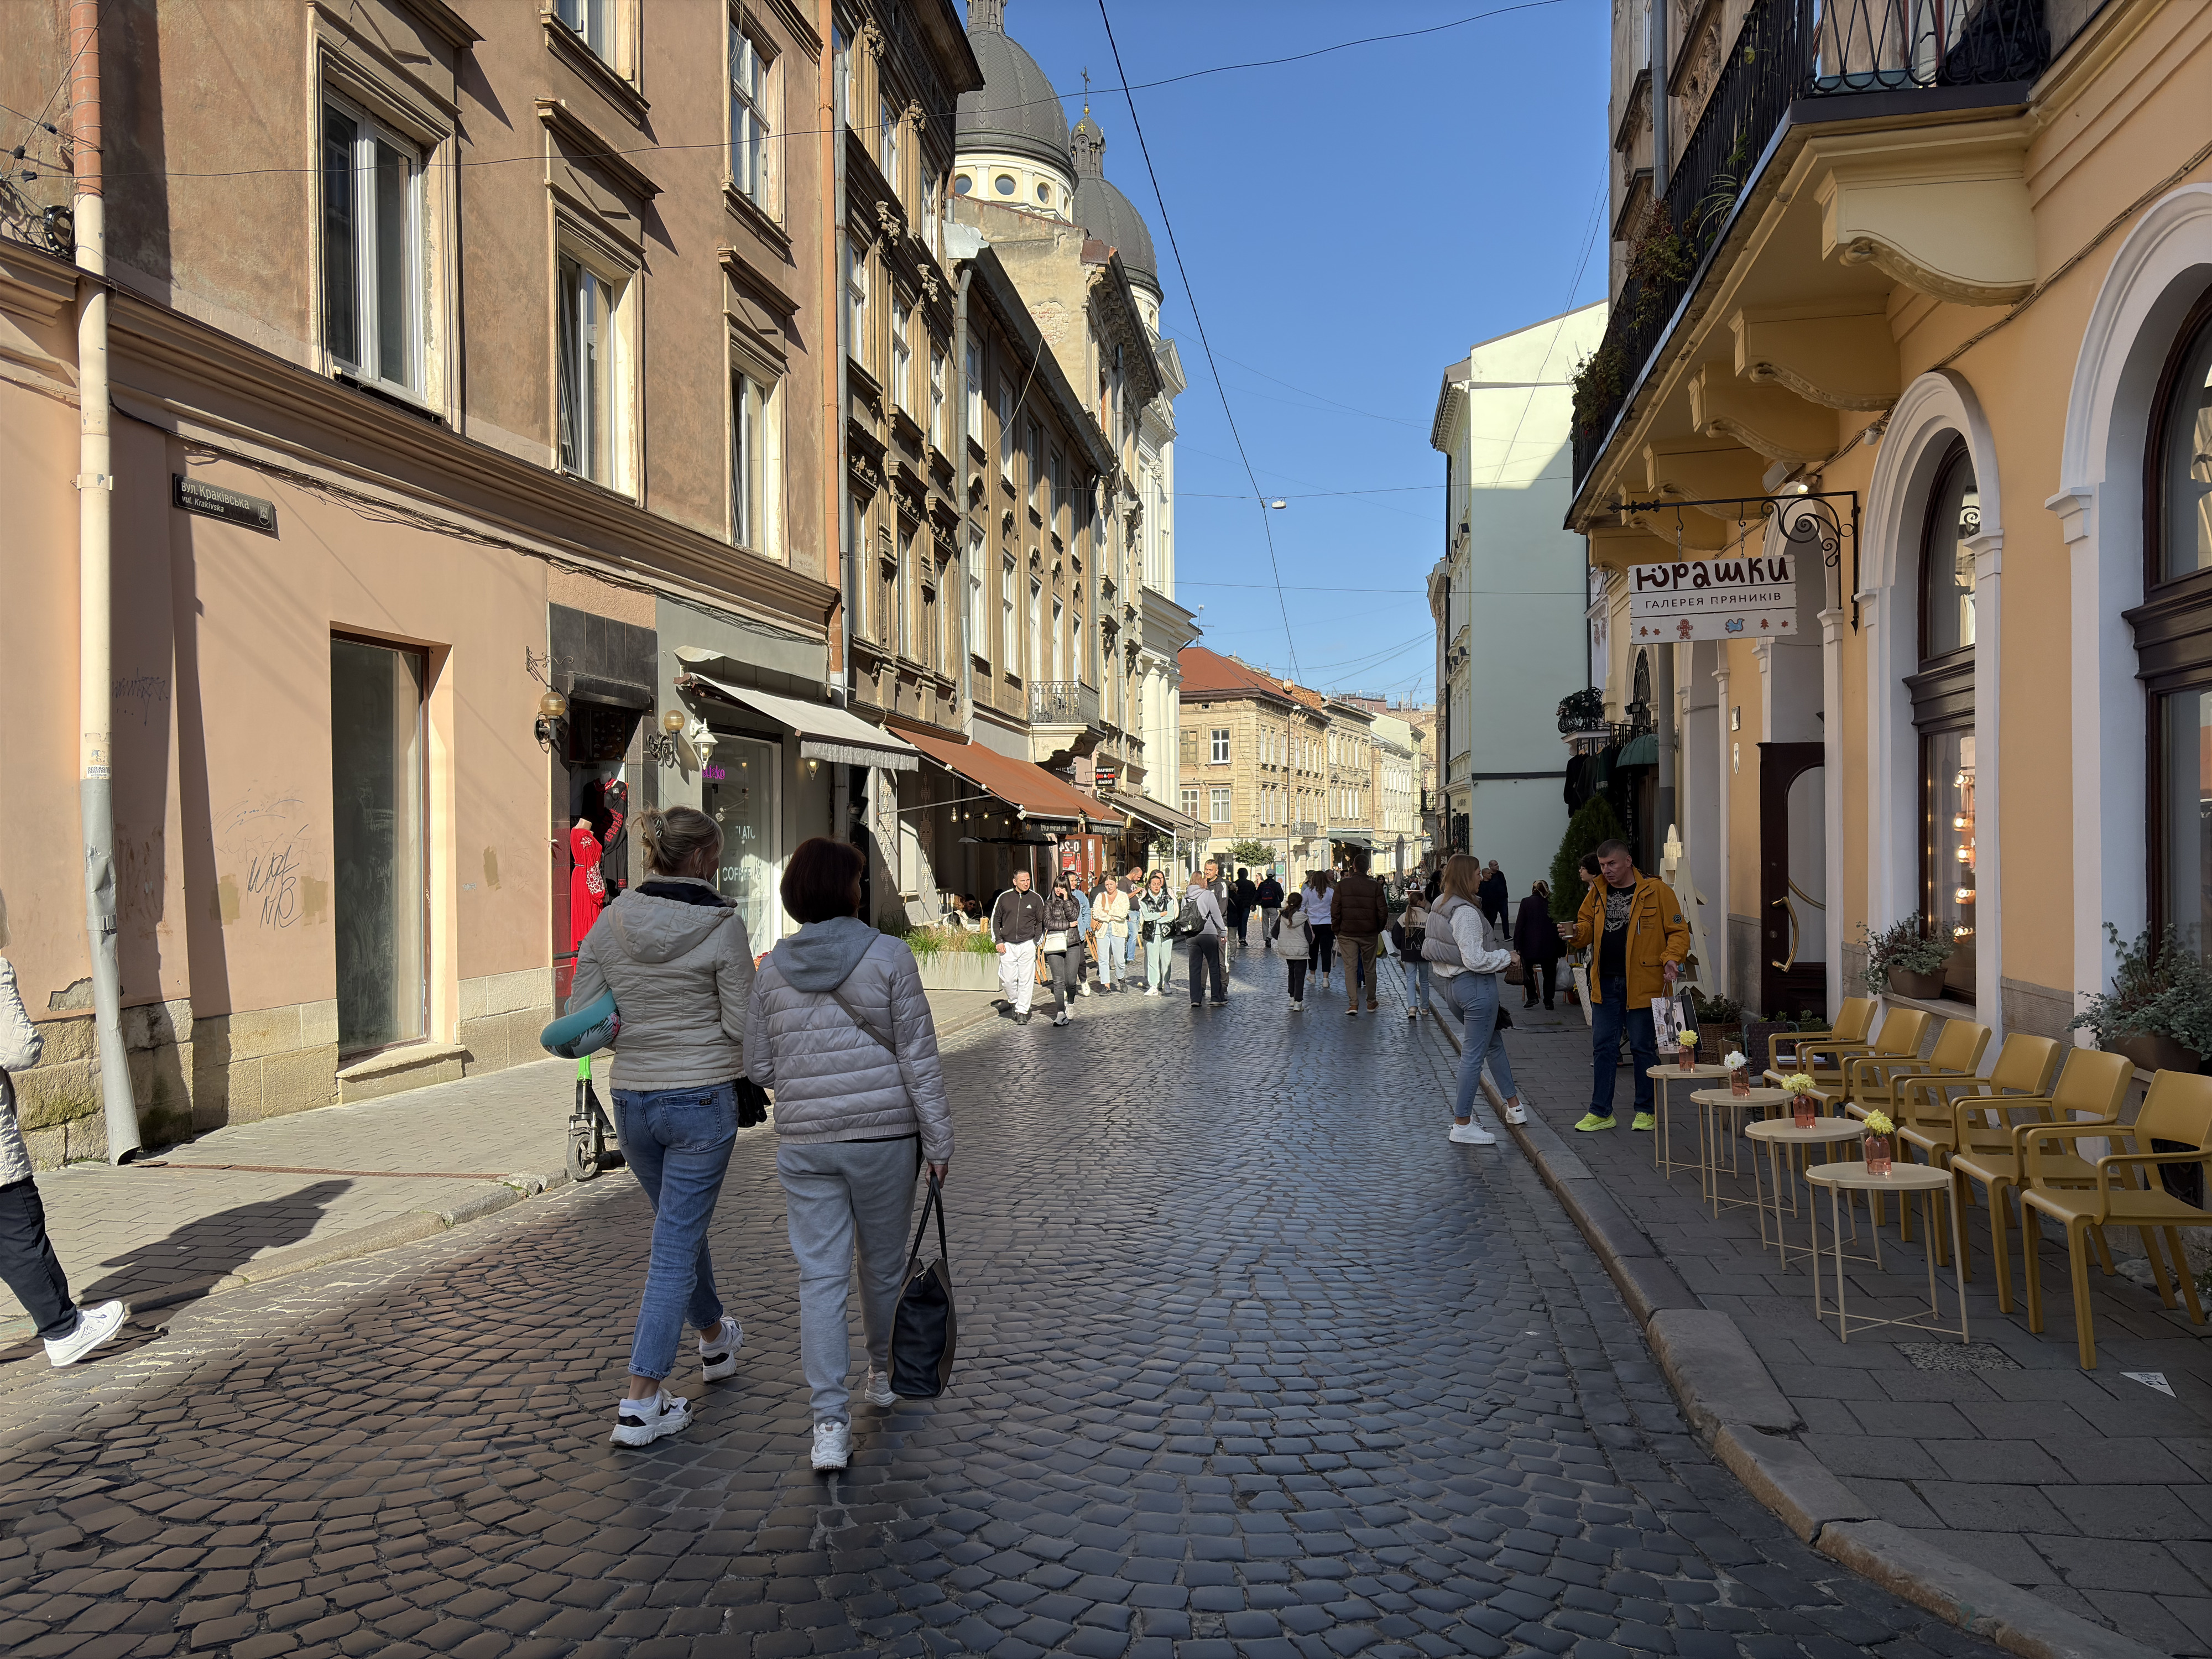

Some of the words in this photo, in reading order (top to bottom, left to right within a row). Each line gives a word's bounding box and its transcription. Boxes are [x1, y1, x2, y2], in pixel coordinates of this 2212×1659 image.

[181, 482, 198, 495] вул.
[199, 484, 250, 510] Краківська
[181, 495, 192, 504] vul.
[195, 498, 225, 513] Krakivska
[1645, 597, 1704, 609] ГАЛЕРЕЯ
[1710, 592, 1782, 604] ПРЯНИКІВ
[722, 867, 751, 881] COFFEE
[742, 907, 761, 922] MORE
